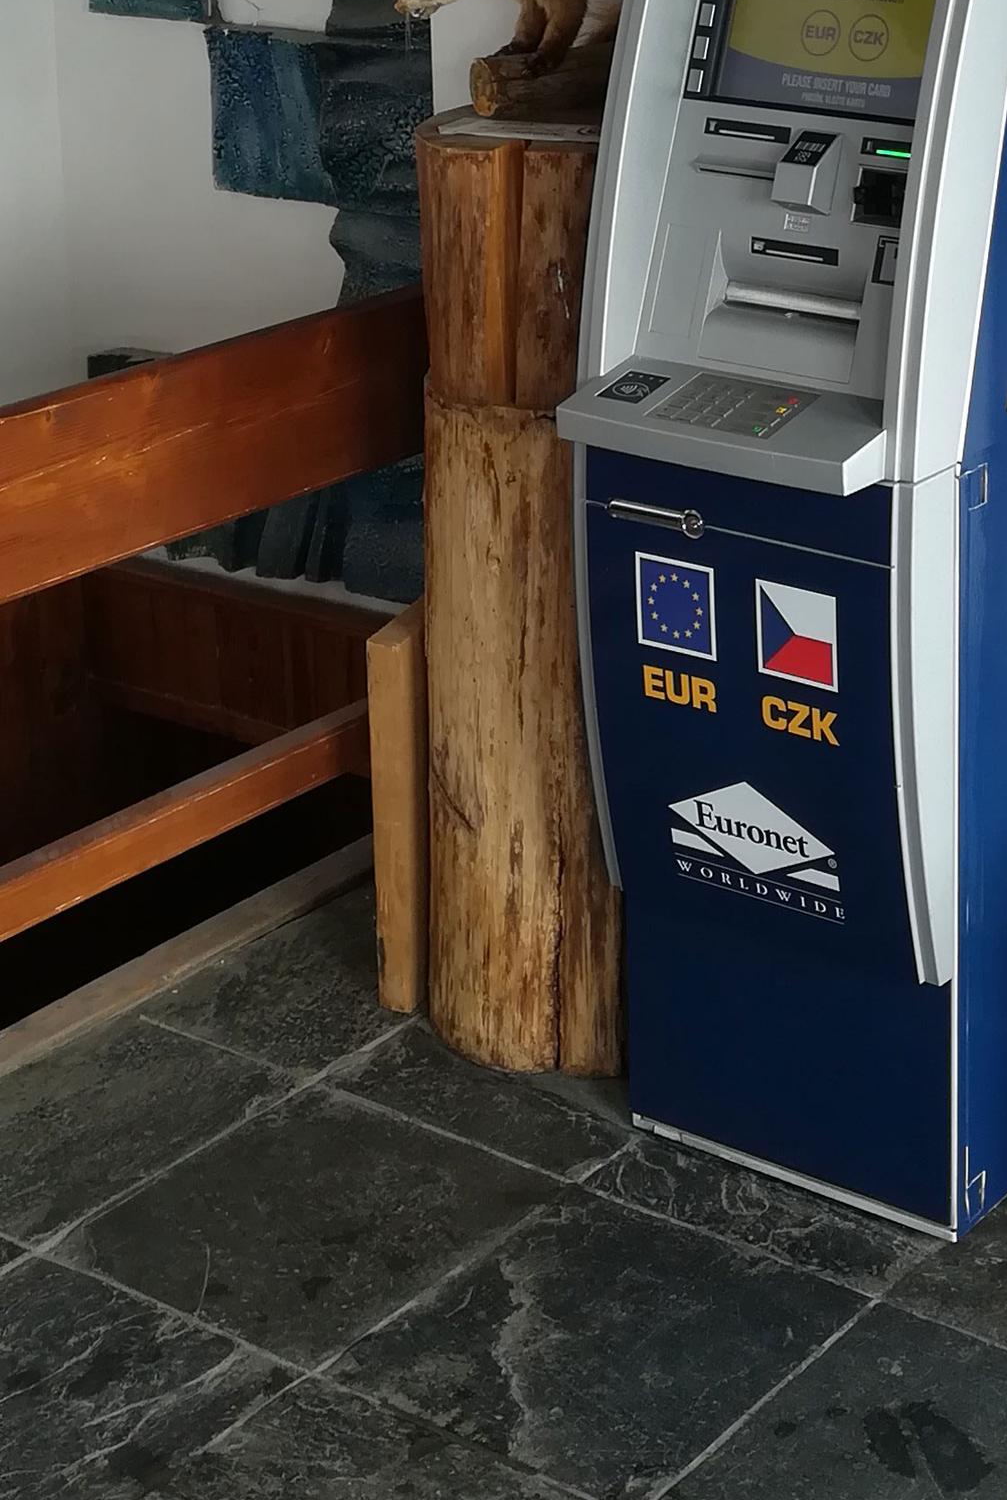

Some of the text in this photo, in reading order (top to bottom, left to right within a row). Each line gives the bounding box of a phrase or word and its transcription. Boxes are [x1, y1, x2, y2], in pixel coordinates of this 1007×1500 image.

[805, 24, 837, 41] EUR
[853, 30, 885, 46] CZK
[782, 73, 812, 89] PLEASE
[813, 77, 844, 93] INSERT
[845, 80, 867, 95] YOUR
[642, 664, 718, 714] EUR
[761, 694, 840, 746] CZK
[695, 799, 810, 859] Euronet
[676, 858, 846, 920] WORLDWIDE
